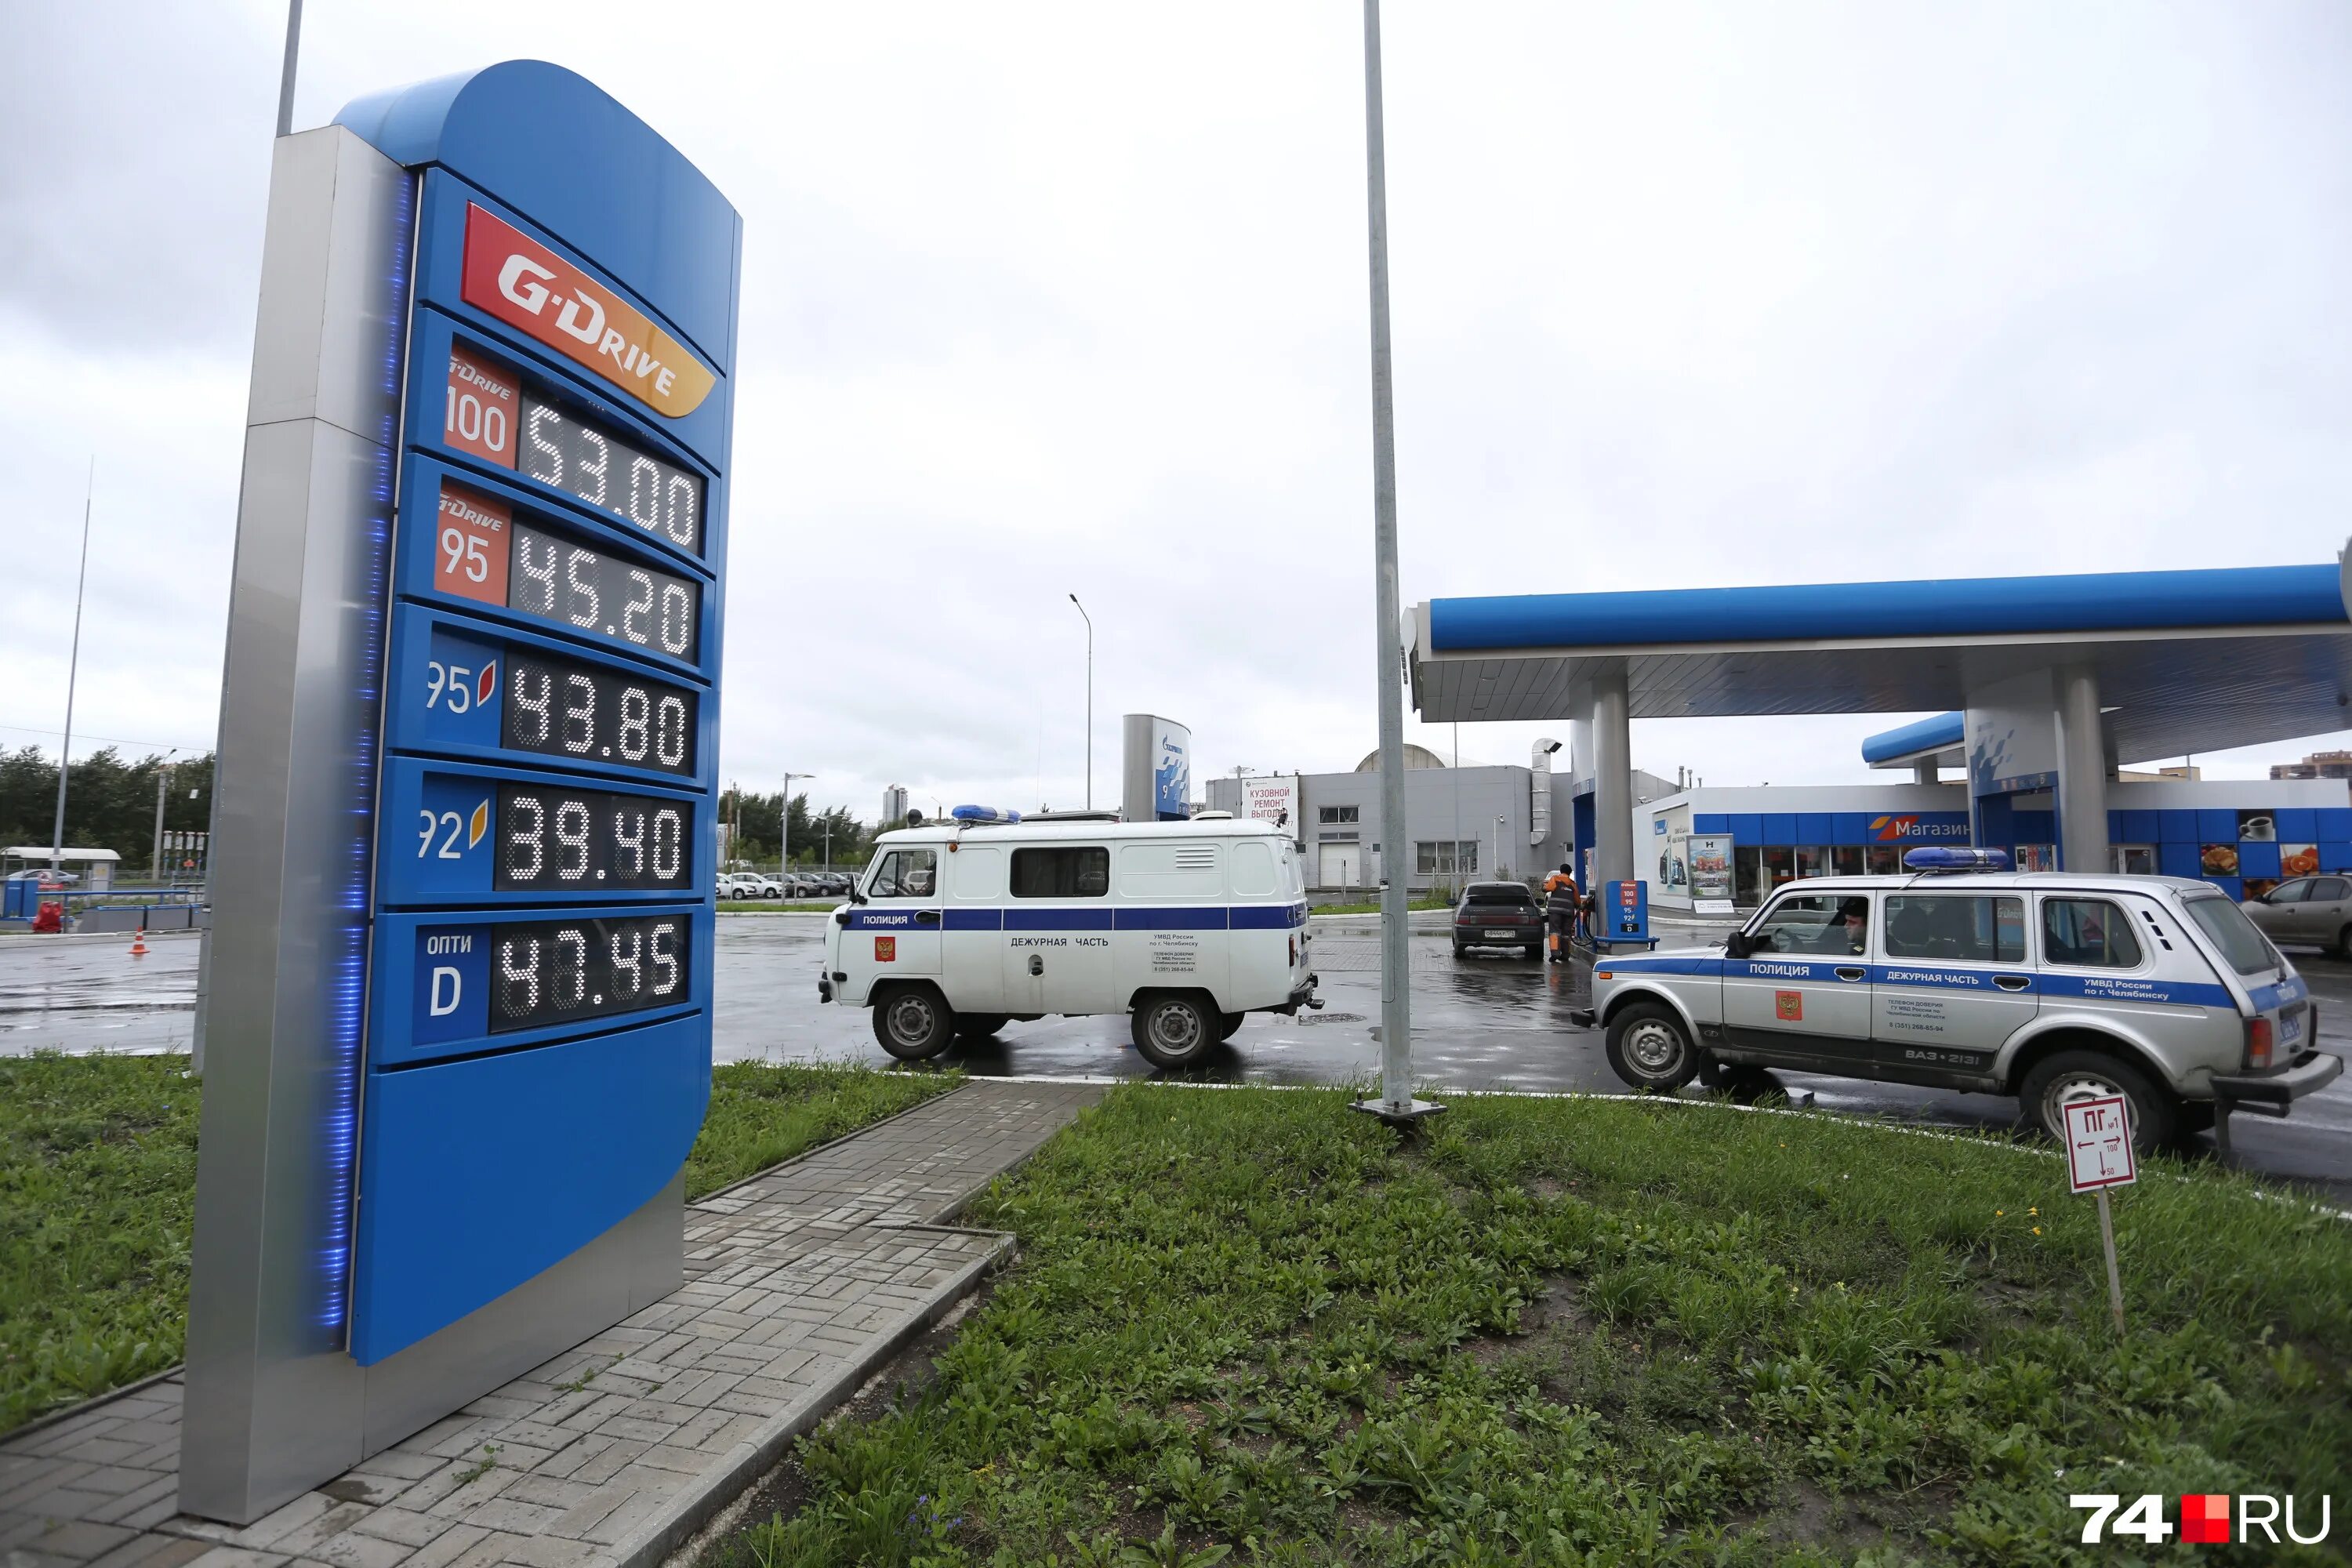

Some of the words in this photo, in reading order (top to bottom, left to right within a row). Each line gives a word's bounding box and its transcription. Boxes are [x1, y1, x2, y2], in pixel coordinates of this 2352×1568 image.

[447, 385, 506, 452] 100
[528, 405, 695, 546] 53.00
[441, 528, 488, 583] 95
[520, 536, 689, 655] 45.20
[426, 661, 470, 713] 95
[514, 668, 685, 767] 43.80
[1250, 786, 1290, 798] КУЗОВНОЙ
[1254, 799, 1285, 808] РЕМОНТ
[418, 810, 463, 858] 92
[1895, 821, 1971, 836] Магазин
[506, 797, 681, 880] 39.40
[863, 915, 908, 925] ПОЛИЦИЯ
[426, 935, 472, 955] ОПТИ
[1011, 938, 1067, 947] ДЕЖУРНАЯ
[1075, 938, 1109, 947] ЧАСТЬ
[502, 924, 678, 1008] 47.45
[1749, 964, 1810, 977] ПОЛИЦИЯ
[1887, 971, 1942, 982] ДЕЖУРНАЯ
[1945, 975, 1979, 985] ЧАСТЬ
[2084, 979, 2113, 988] УМВД
[2115, 981, 2152, 990] России
[430, 967, 462, 1017] D
[2107, 989, 2169, 1001] Челябинску
[1906, 1050, 1937, 1061] ВАЗ
[2083, 1109, 2105, 1133] ПГ
[2107, 1144, 2118, 1152] 100
[2107, 1167, 2114, 1176] 50
